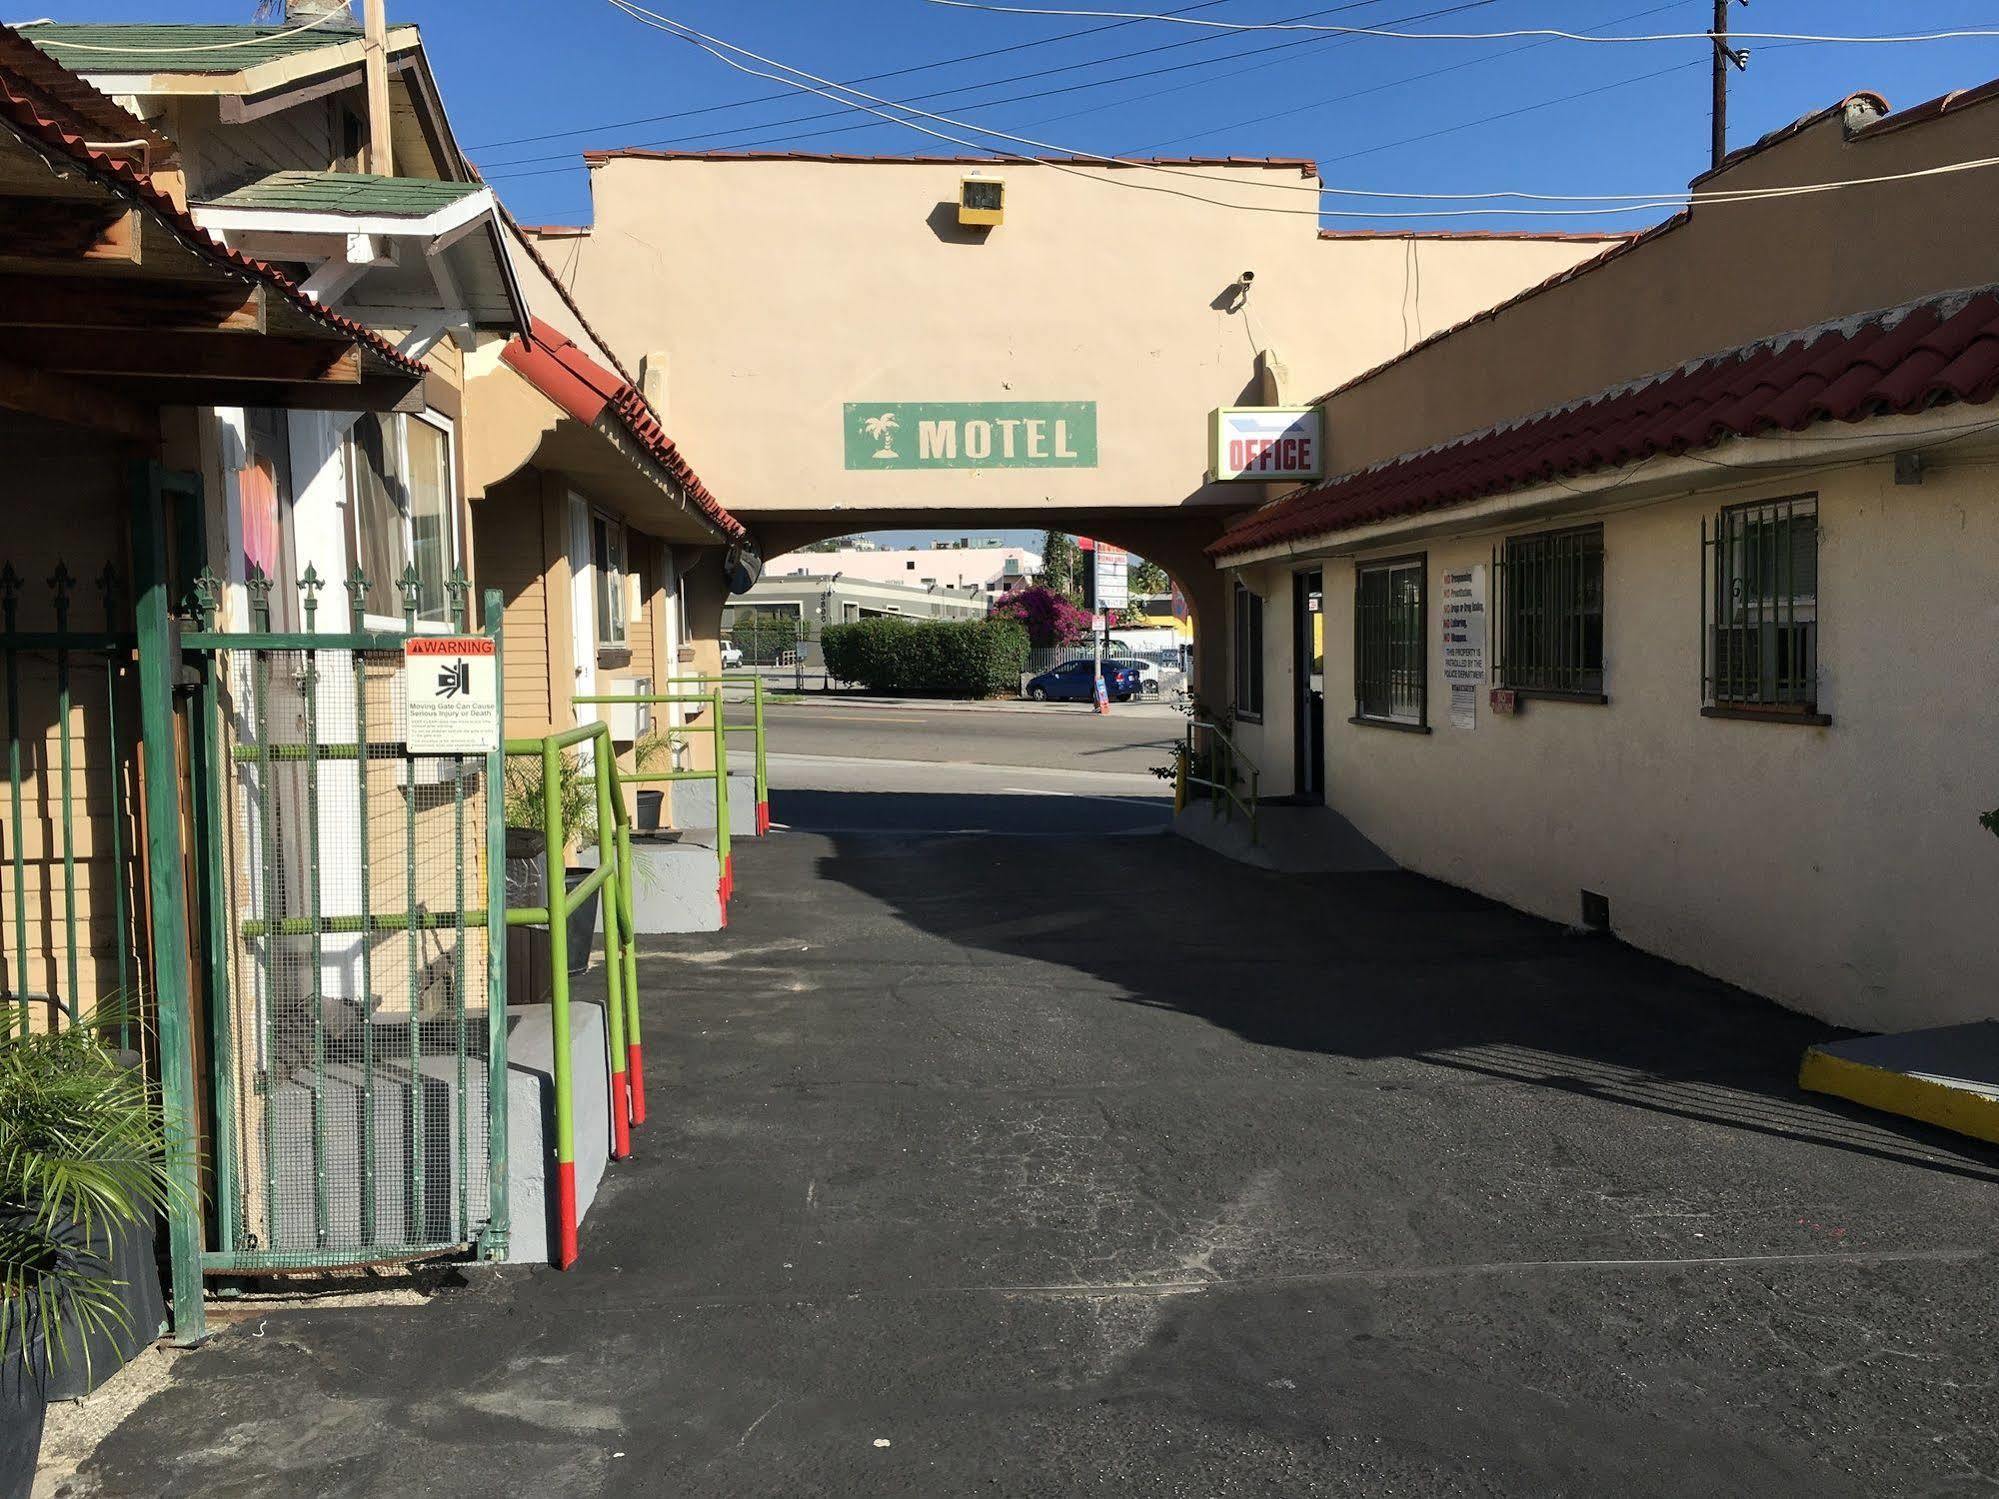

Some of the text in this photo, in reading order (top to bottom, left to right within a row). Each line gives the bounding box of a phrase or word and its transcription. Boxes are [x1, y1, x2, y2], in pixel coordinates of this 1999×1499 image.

[918, 419, 1078, 459] MOTEL
[1229, 438, 1311, 471] OFFICE
[423, 641, 492, 653] WARNING
